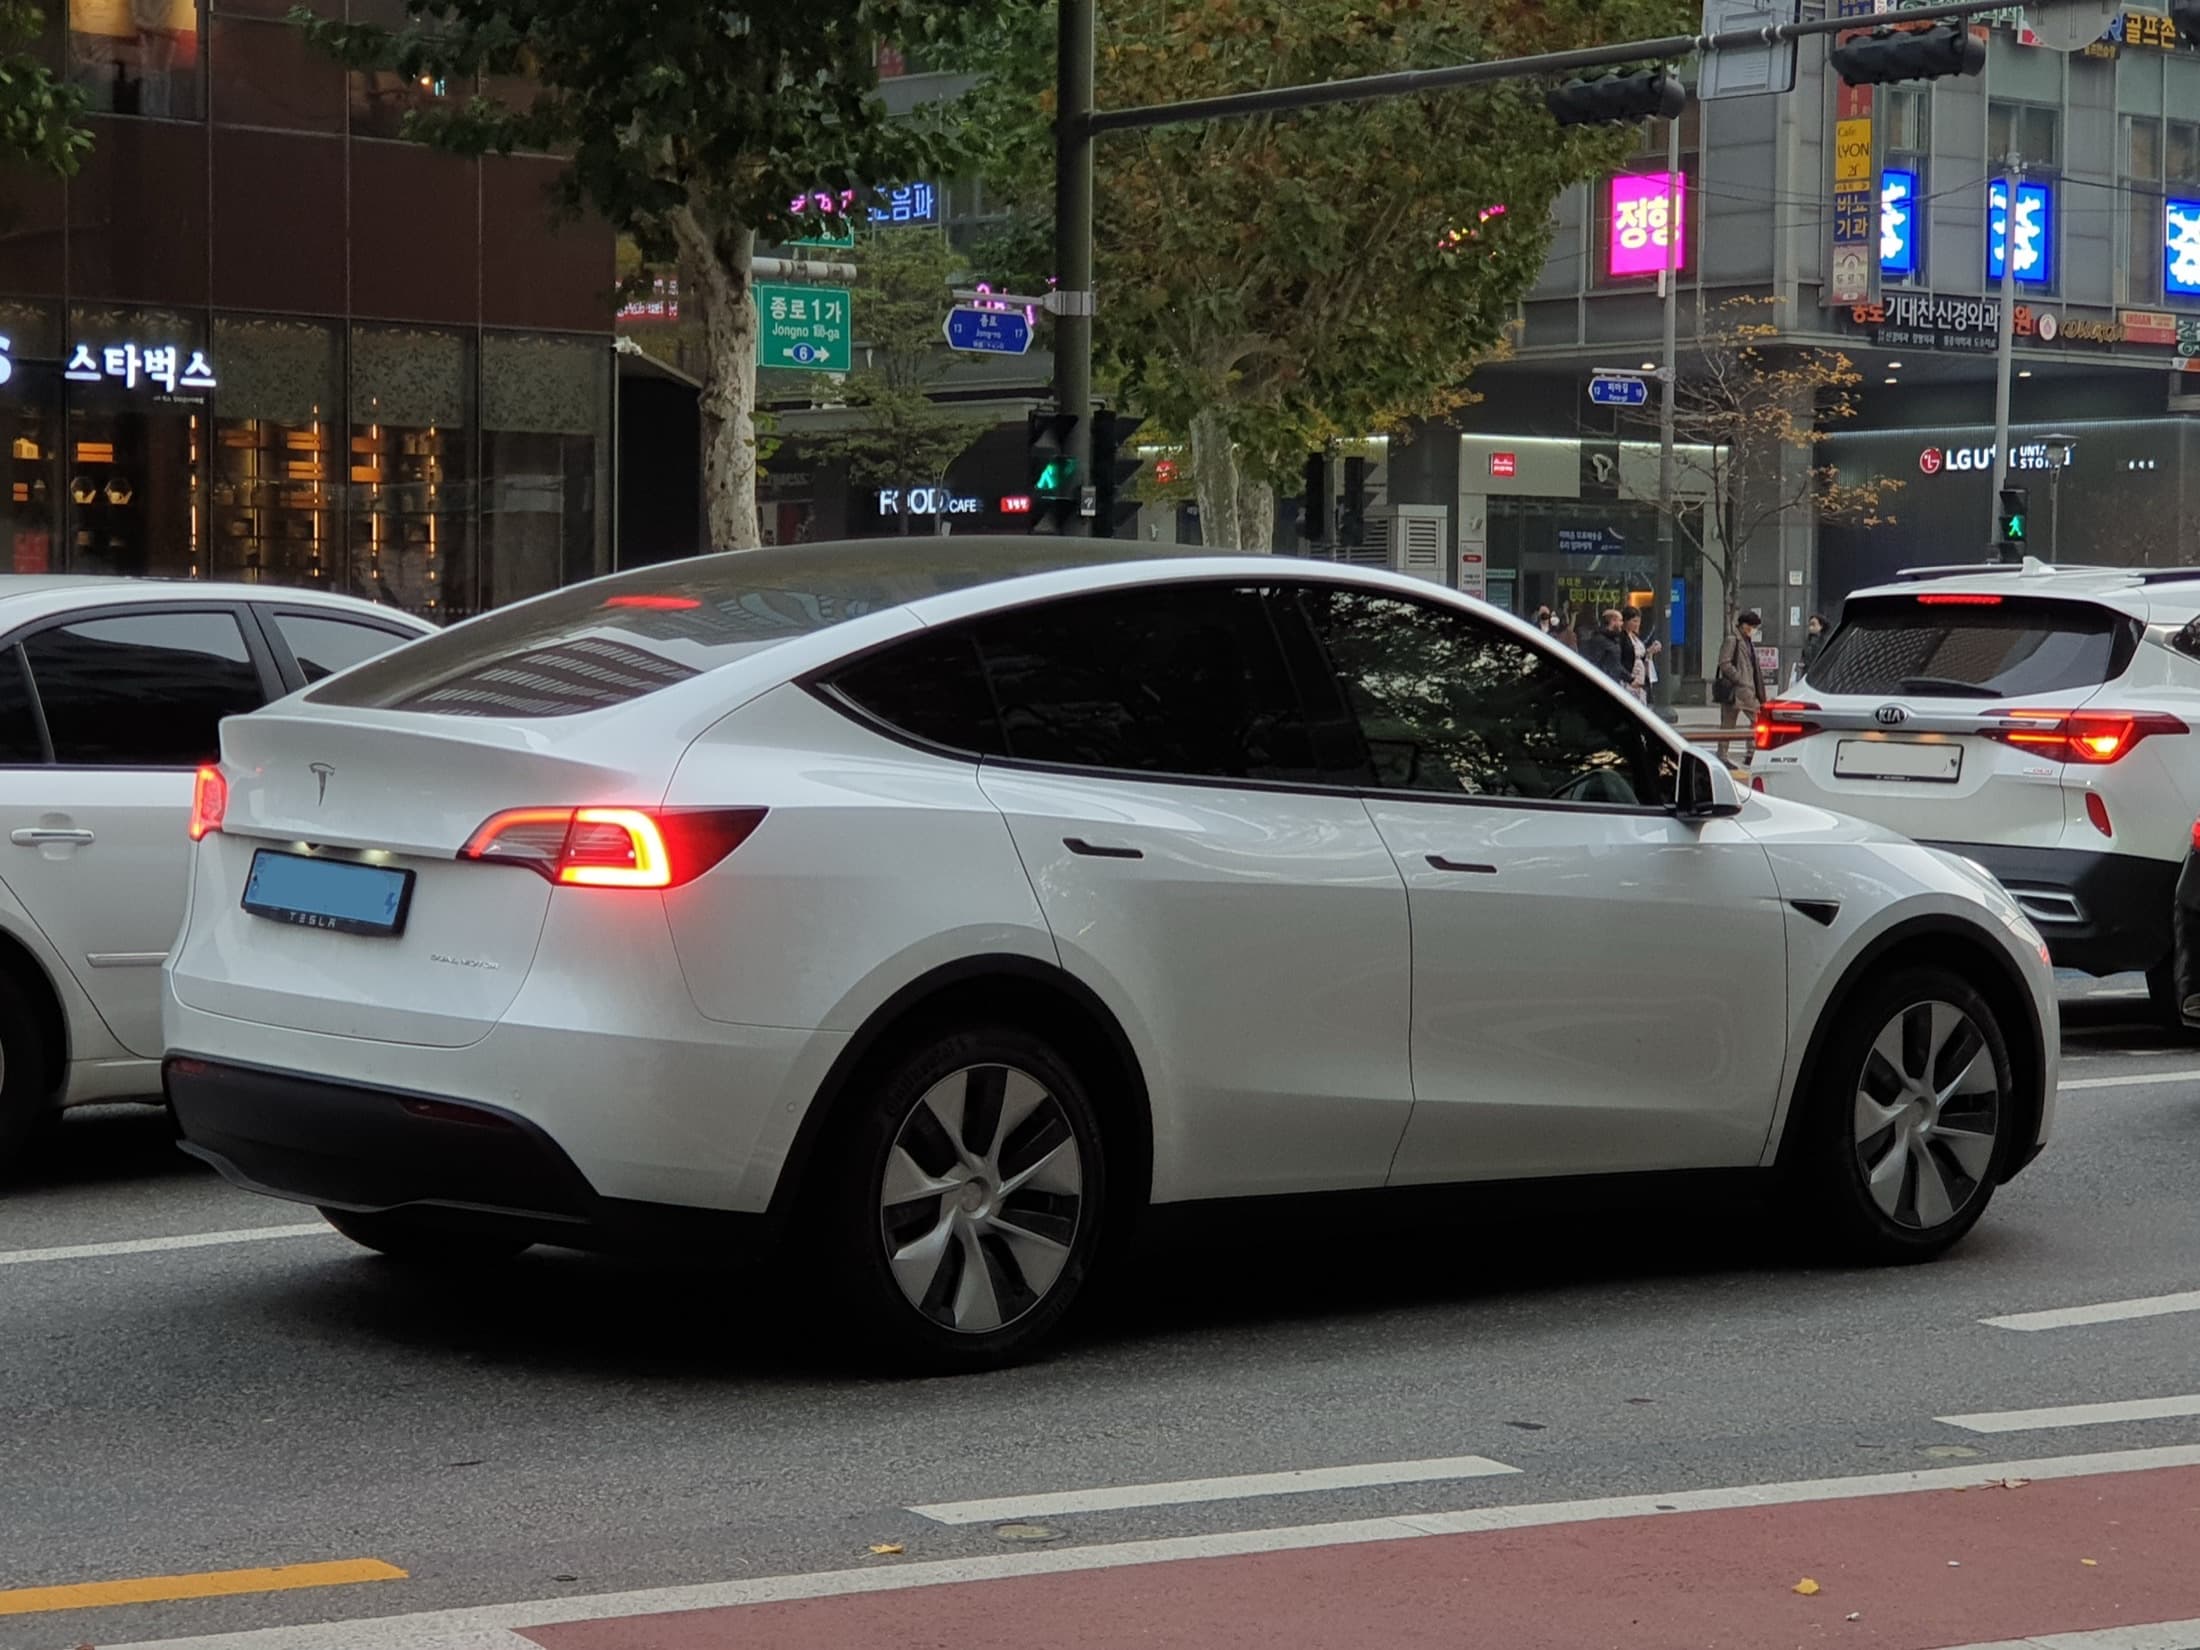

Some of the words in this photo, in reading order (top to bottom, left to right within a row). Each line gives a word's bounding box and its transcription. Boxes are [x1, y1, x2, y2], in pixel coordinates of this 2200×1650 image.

[2126, 13, 2176, 49] 골프존
[1836, 218, 1868, 239] 기과
[772, 322, 809, 340] Jongno
[799, 346, 809, 361] 6
[64, 344, 217, 393] 스타벅스
[950, 498, 977, 513] CAFE
[1878, 707, 1906, 724] KIA
[289, 911, 337, 928] TESLA
